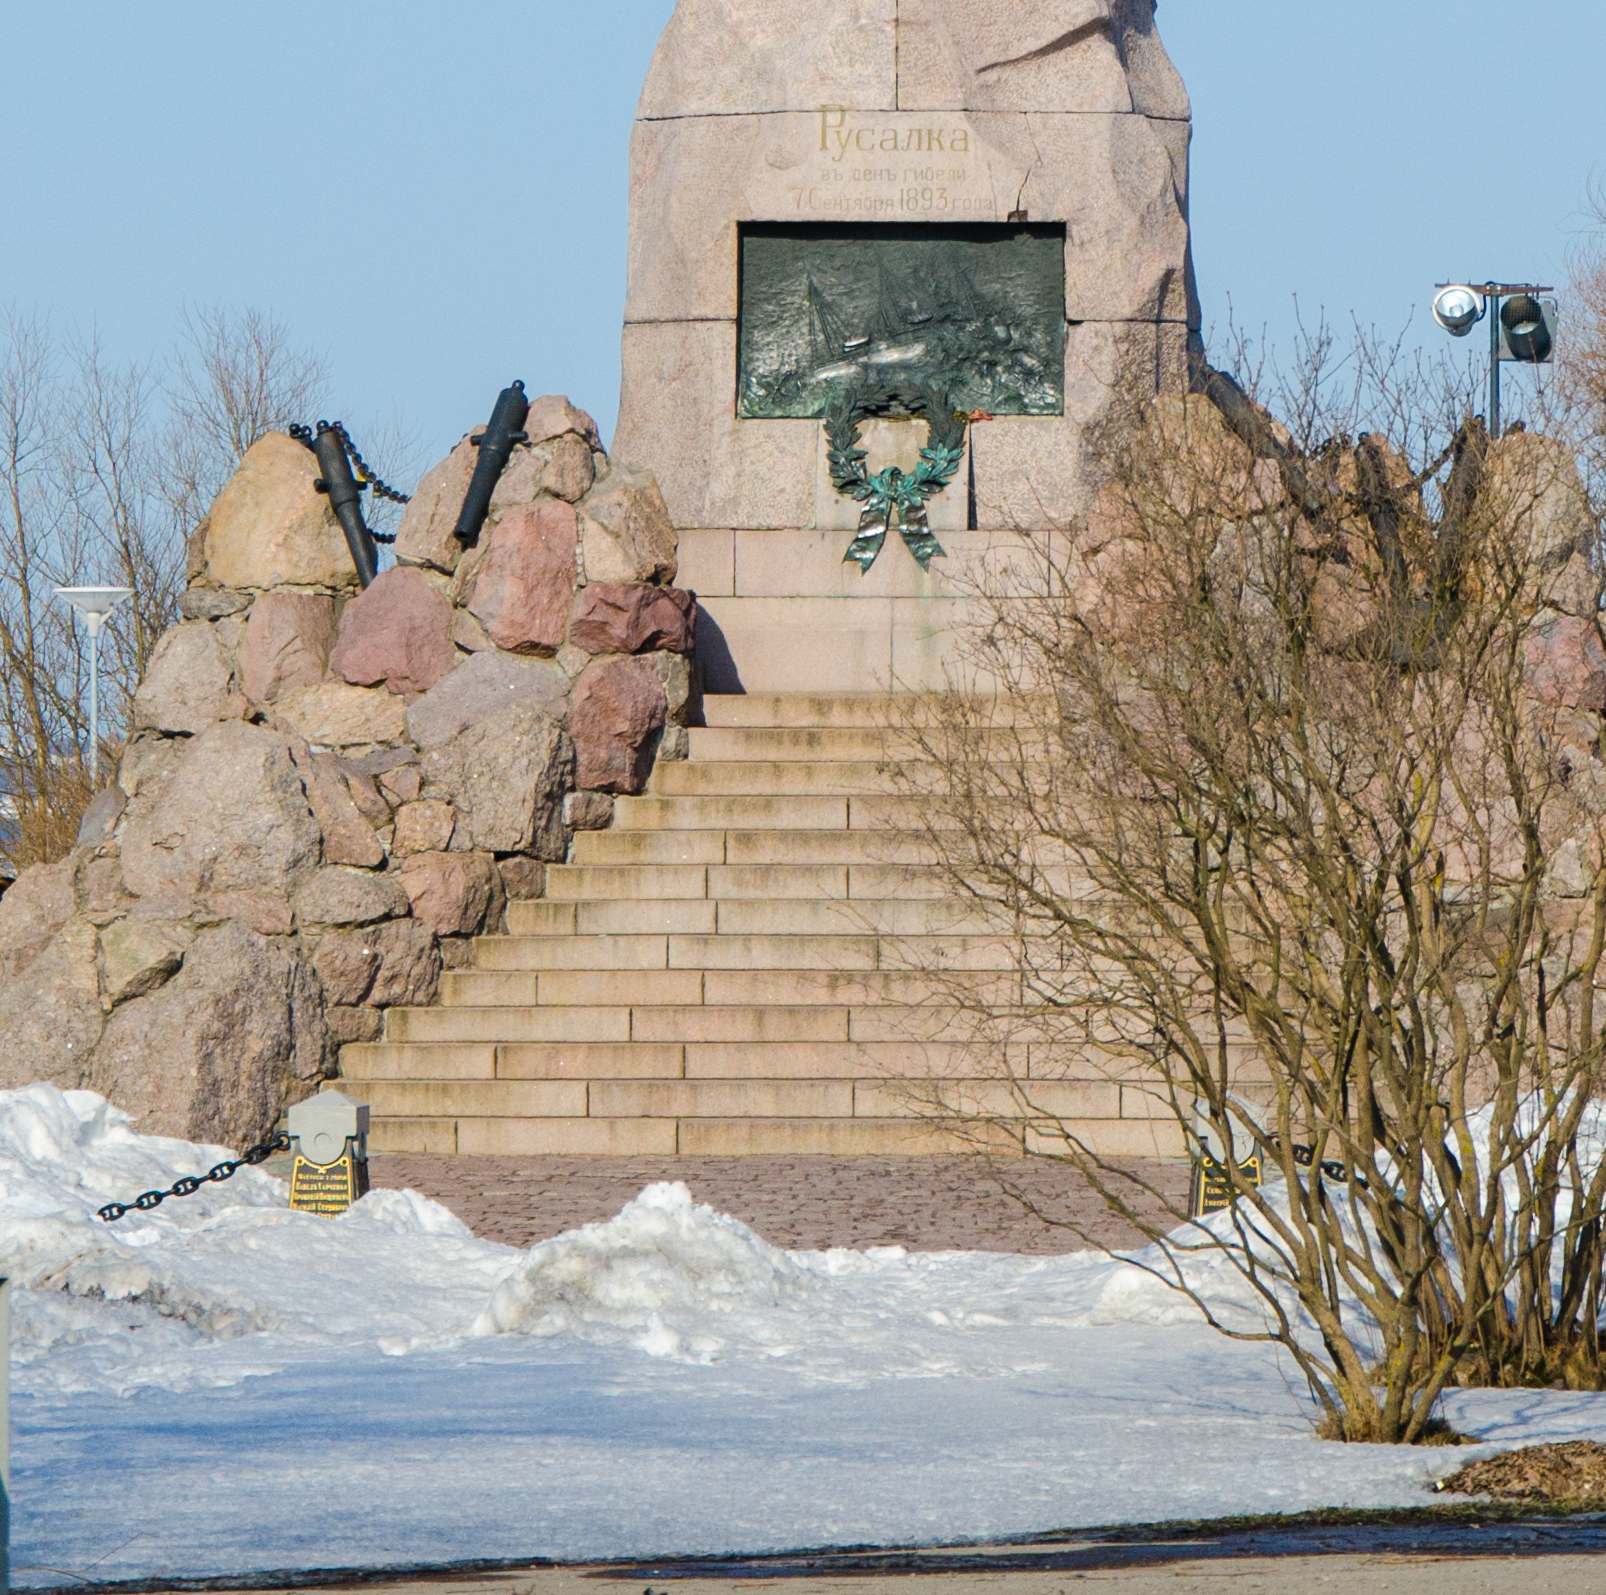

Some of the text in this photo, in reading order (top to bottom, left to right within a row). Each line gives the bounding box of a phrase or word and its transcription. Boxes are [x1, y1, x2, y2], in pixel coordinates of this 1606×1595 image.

[818, 103, 970, 162] Русалка
[903, 166, 967, 182] гибели
[789, 186, 994, 212] 7 Сентября 1893 года
